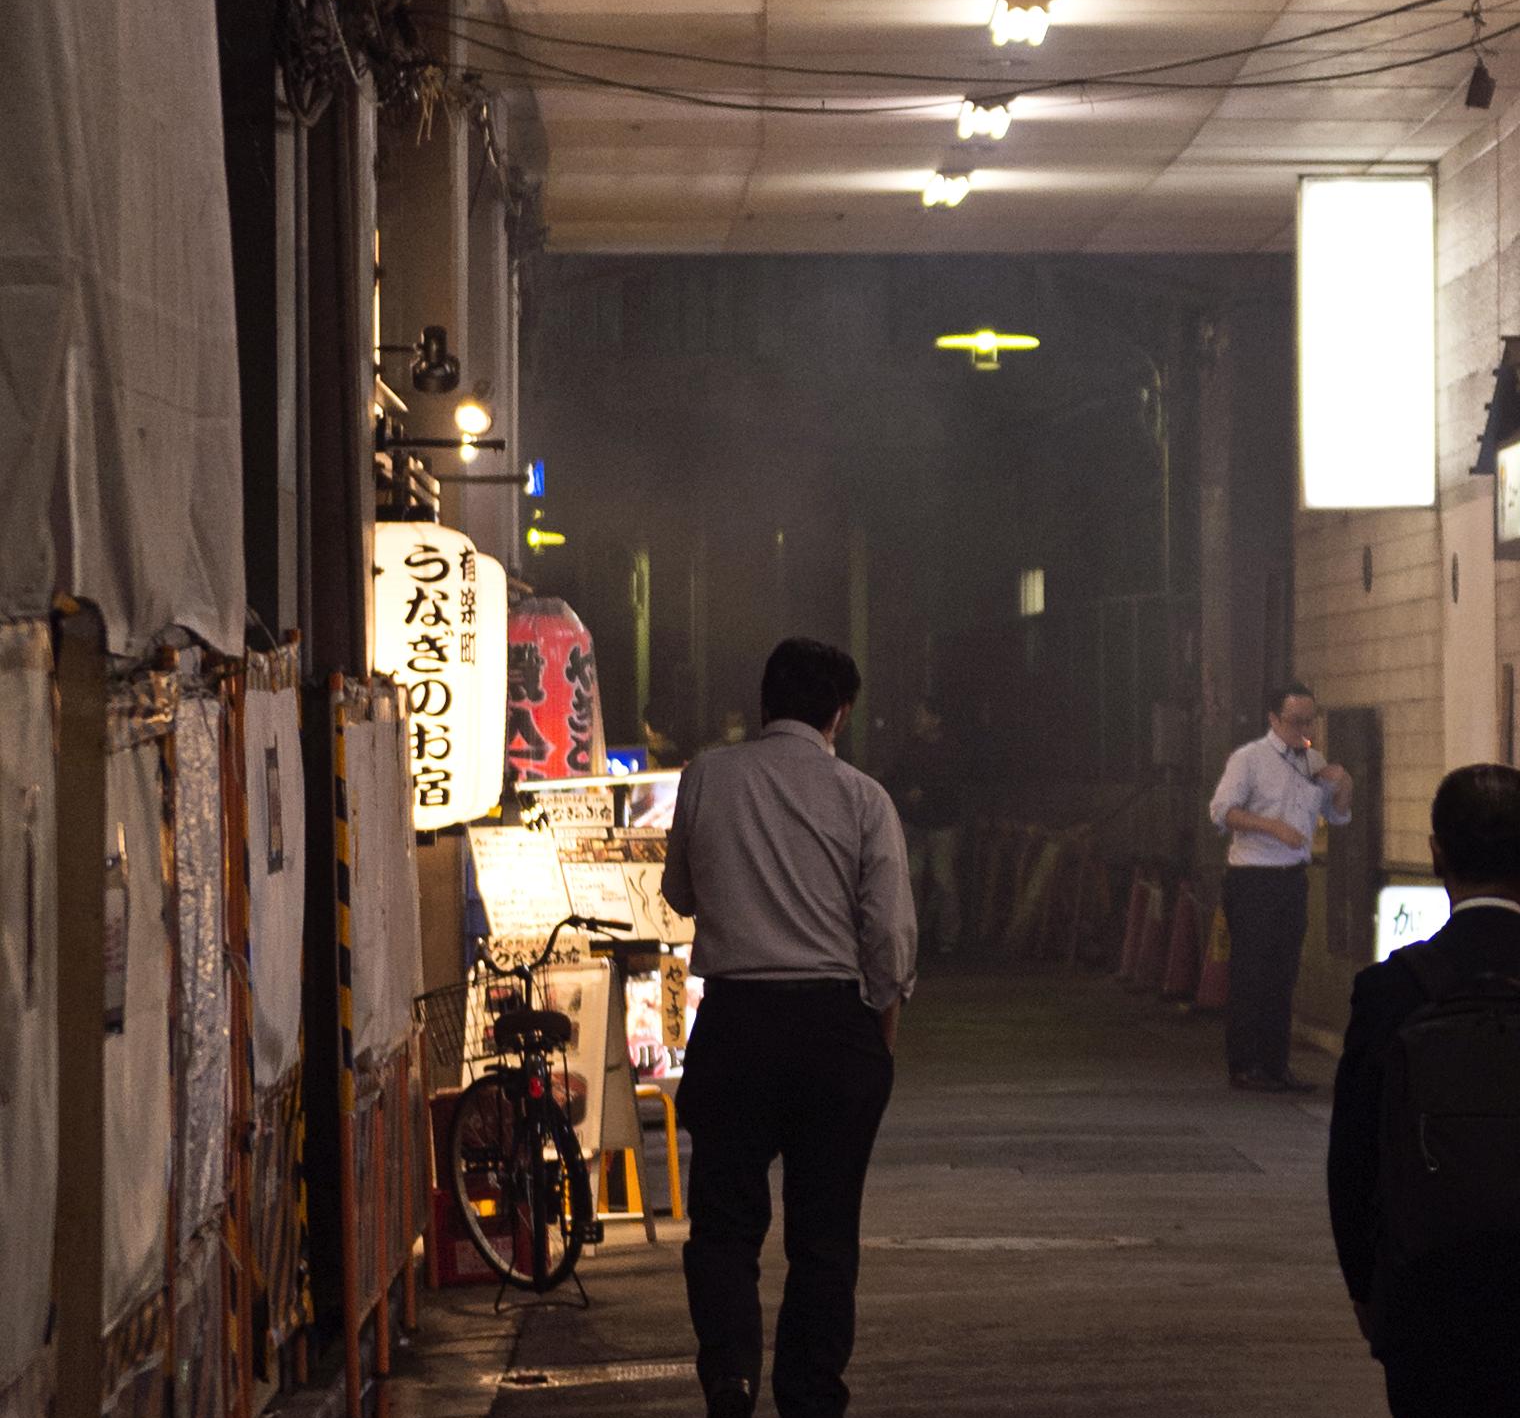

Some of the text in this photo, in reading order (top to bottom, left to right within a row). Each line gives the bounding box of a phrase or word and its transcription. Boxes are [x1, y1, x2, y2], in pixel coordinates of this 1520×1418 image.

[404, 543, 452, 806] うなぎのお宿
[459, 545, 476, 665] 有楽町
